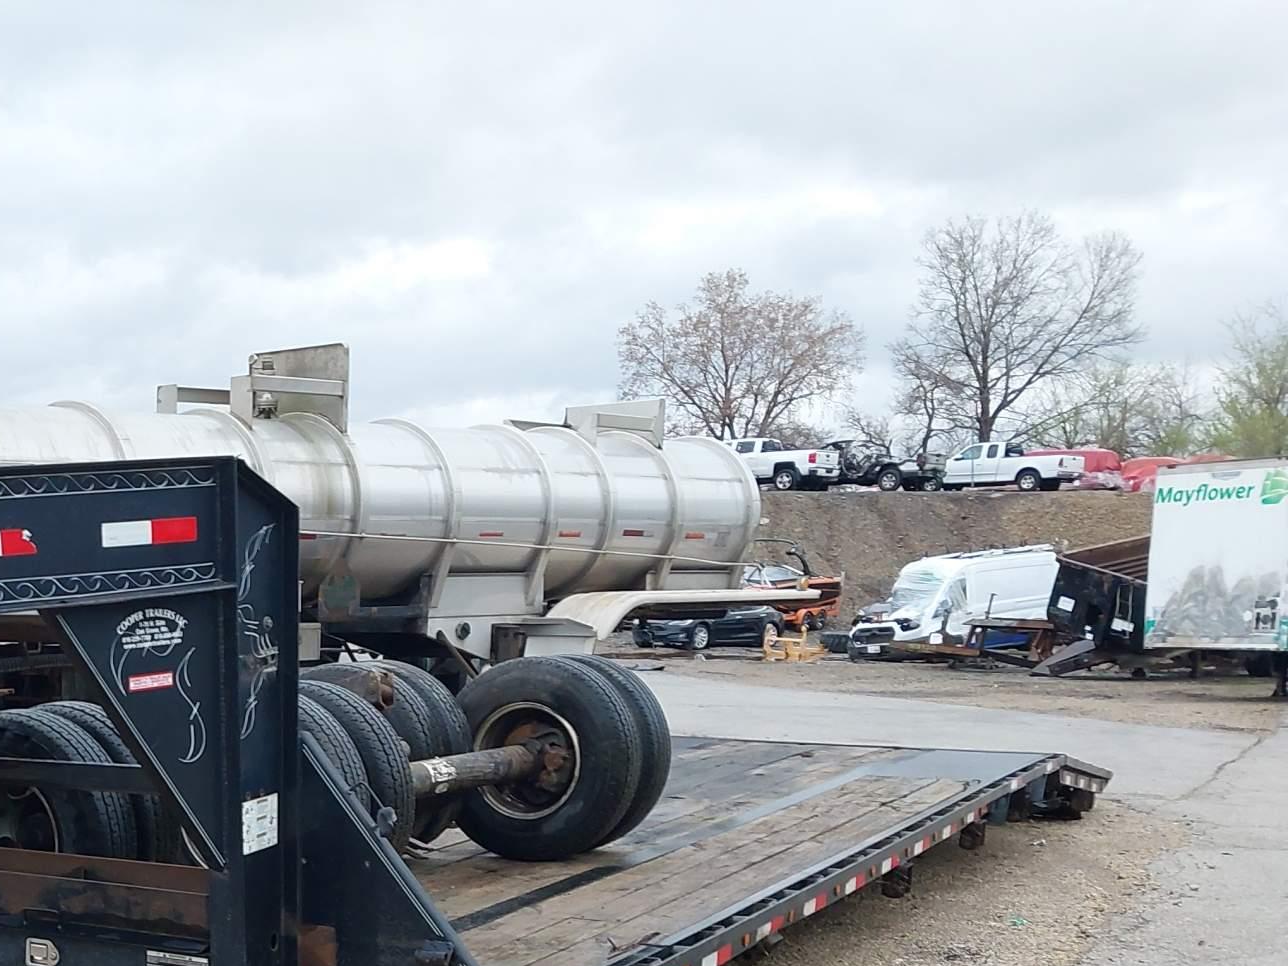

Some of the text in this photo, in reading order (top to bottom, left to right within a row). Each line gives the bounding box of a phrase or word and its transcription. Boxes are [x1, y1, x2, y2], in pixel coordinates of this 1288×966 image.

[1156, 484, 1255, 506] Mayflower
[116, 611, 144, 635] COOPER
[145, 608, 176, 620] TRAILERS
